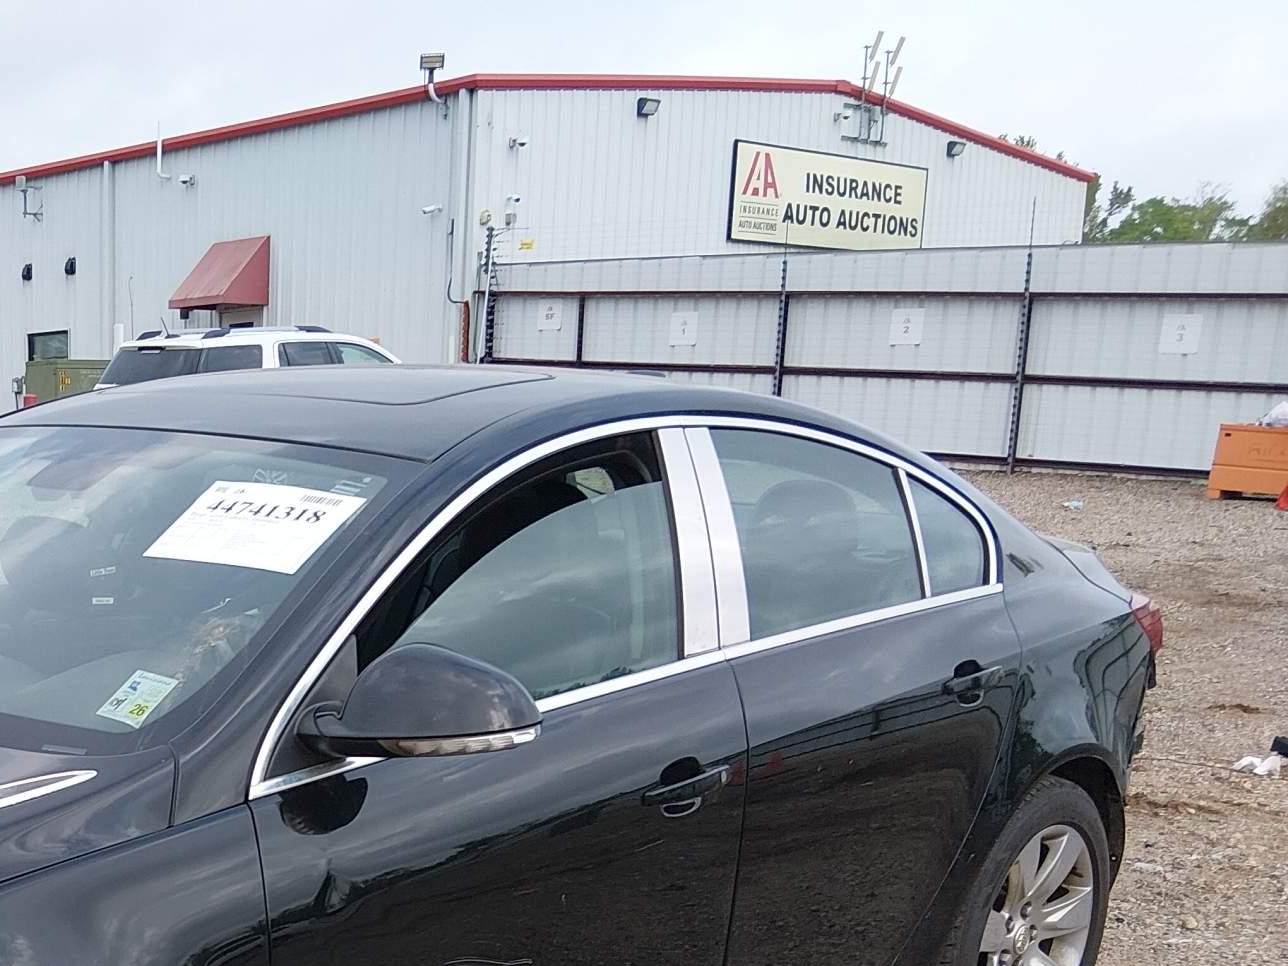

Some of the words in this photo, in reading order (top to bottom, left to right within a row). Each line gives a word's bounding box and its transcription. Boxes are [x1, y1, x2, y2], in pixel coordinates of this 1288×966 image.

[805, 172, 903, 205] INSURANCE
[739, 205, 780, 217] INSURANCE
[782, 202, 831, 227] AUTO
[835, 209, 919, 238] AUCTIONS
[738, 220, 752, 230] AUTO
[752, 221, 778, 232] AUCTIONS
[206, 499, 328, 524] 44741318
[128, 703, 149, 717] 26
